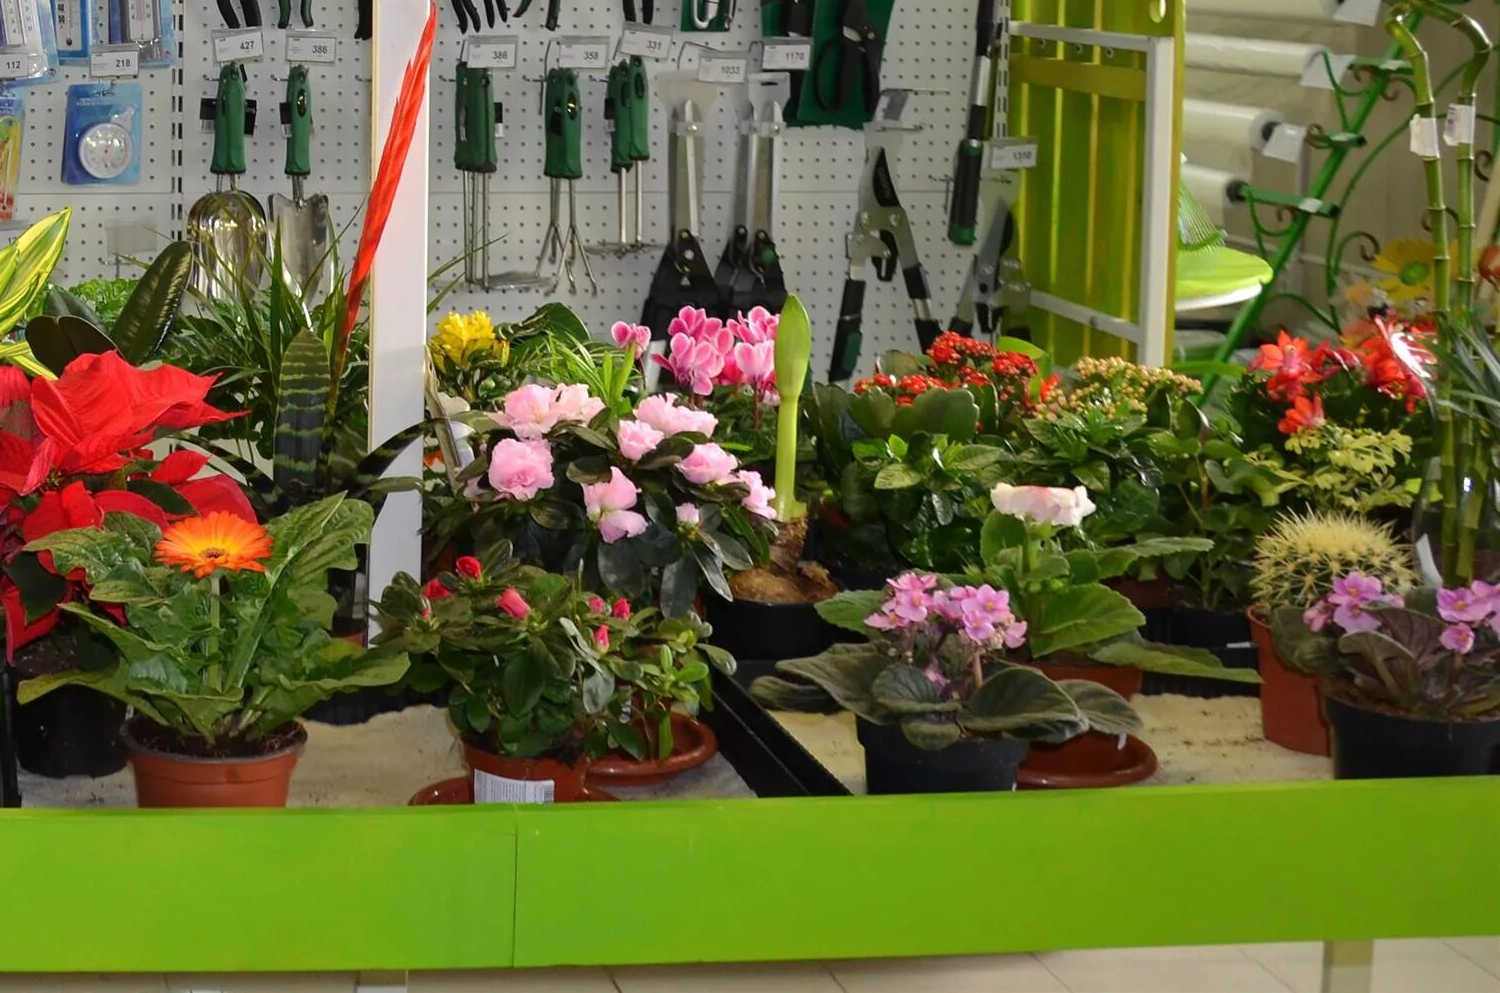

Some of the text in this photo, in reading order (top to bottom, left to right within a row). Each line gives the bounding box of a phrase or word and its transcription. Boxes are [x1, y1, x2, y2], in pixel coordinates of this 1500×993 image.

[239, 40, 255, 51] 427
[312, 45, 328, 55] 386
[5, 60, 21, 70] 112
[115, 58, 131, 68] 218
